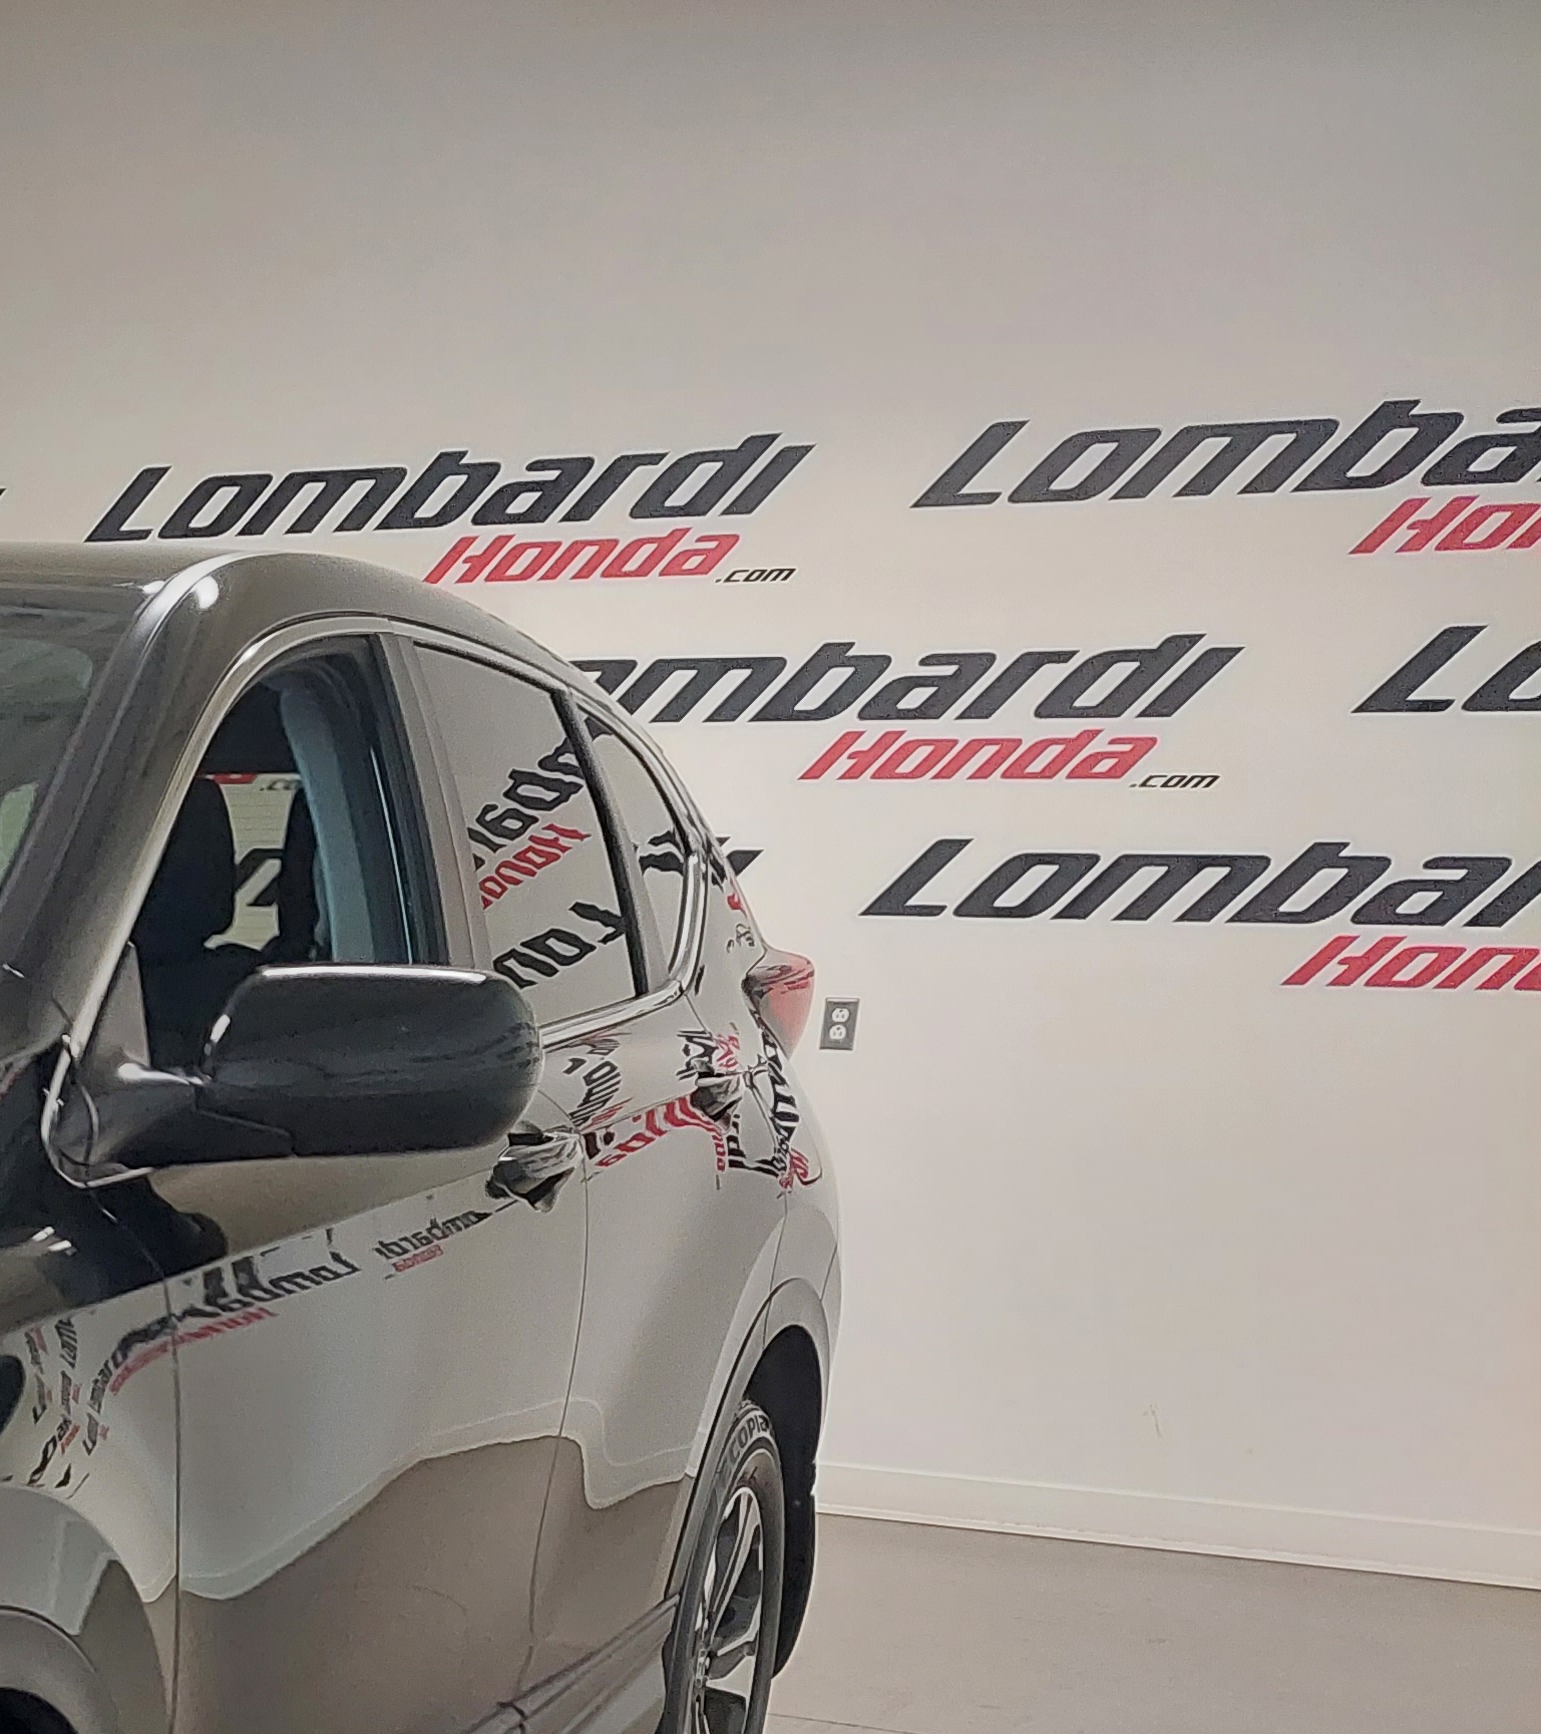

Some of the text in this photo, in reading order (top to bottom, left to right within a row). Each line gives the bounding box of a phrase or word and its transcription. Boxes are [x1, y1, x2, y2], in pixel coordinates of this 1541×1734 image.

[84, 432, 817, 543] Lombardi
[909, 400, 1541, 508] Lomba
[424, 528, 798, 584] Honda .com
[797, 729, 1220, 789] Honda .com
